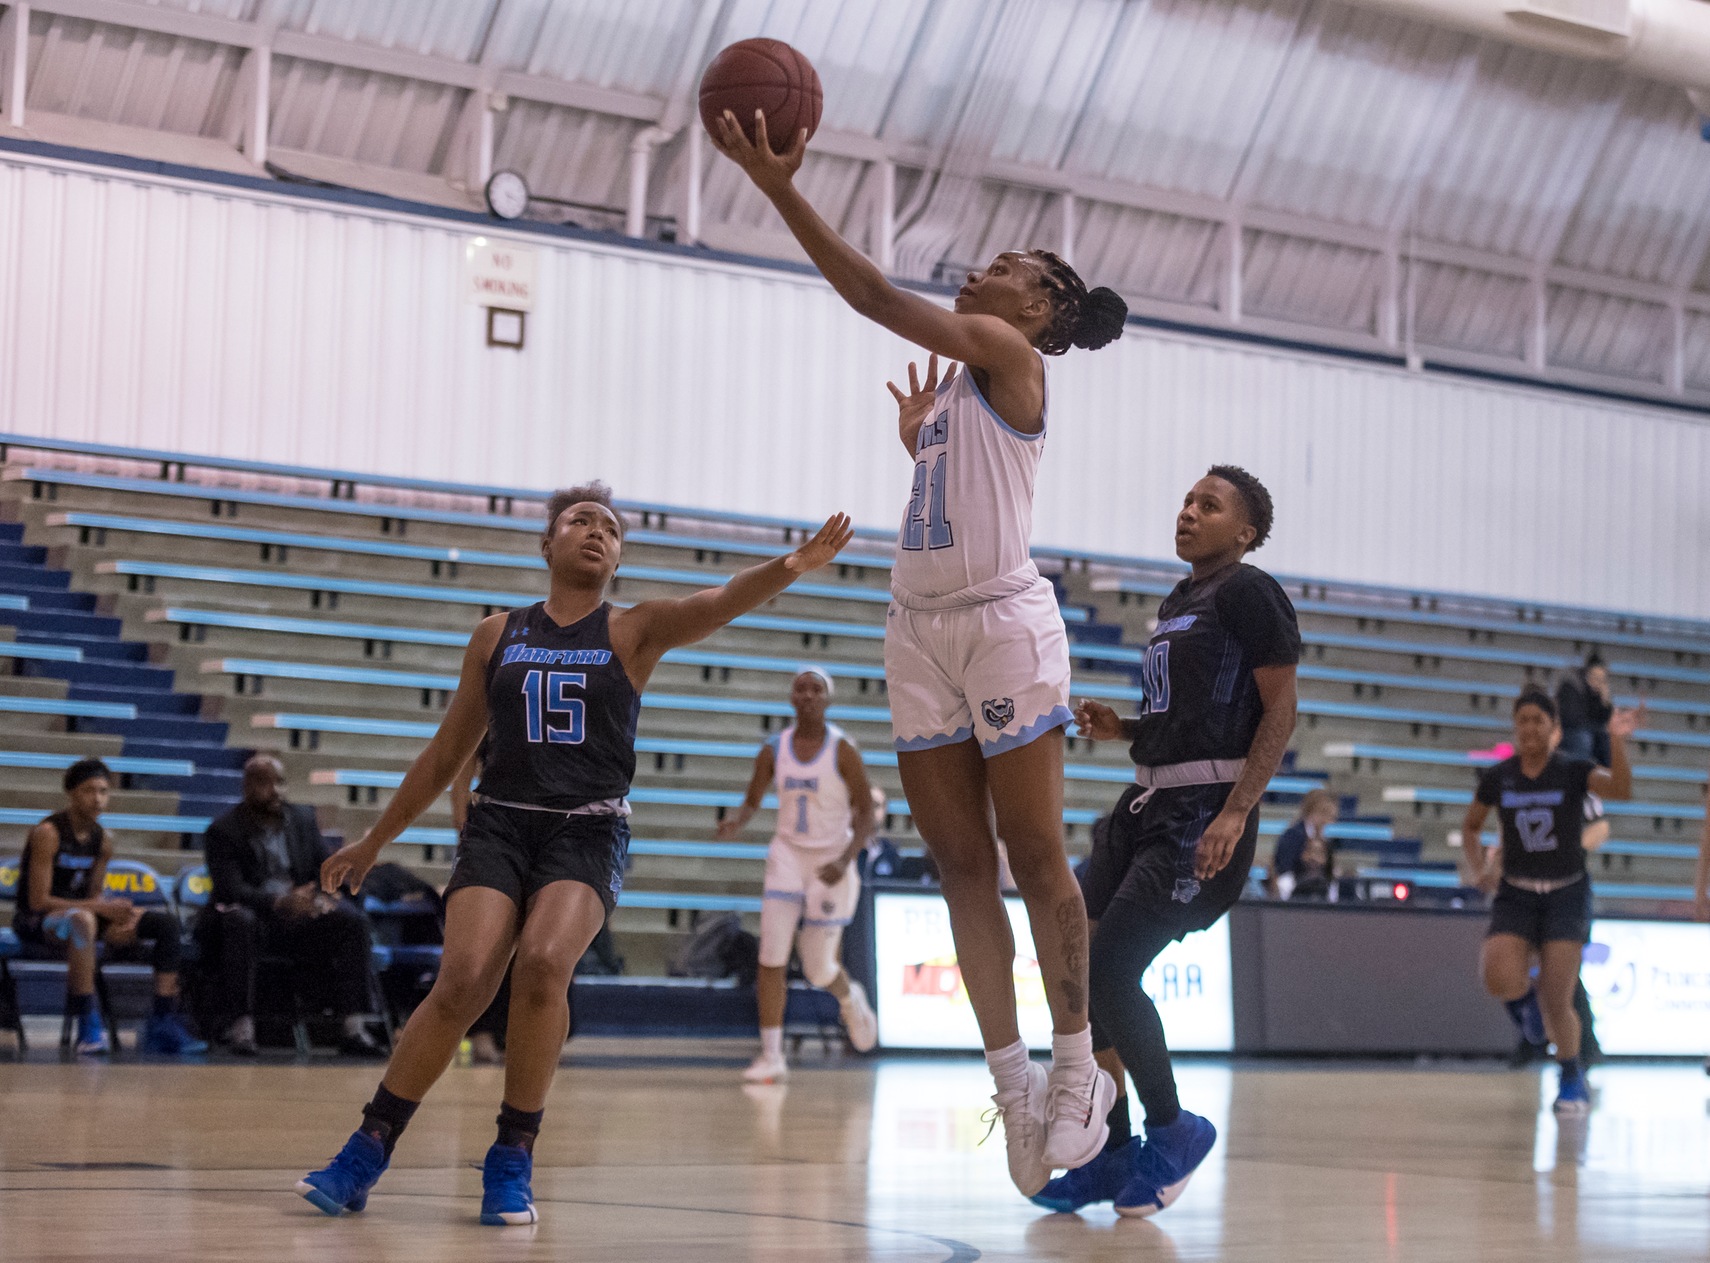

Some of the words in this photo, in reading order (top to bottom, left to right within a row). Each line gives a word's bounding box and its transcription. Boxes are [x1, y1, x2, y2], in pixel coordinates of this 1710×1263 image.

[902, 451, 954, 551] 21
[500, 643, 613, 667] HARFORD
[521, 669, 586, 745] 15
[796, 794, 809, 834] 1
[1515, 808, 1559, 853] 12
[103, 873, 156, 893] WLS
